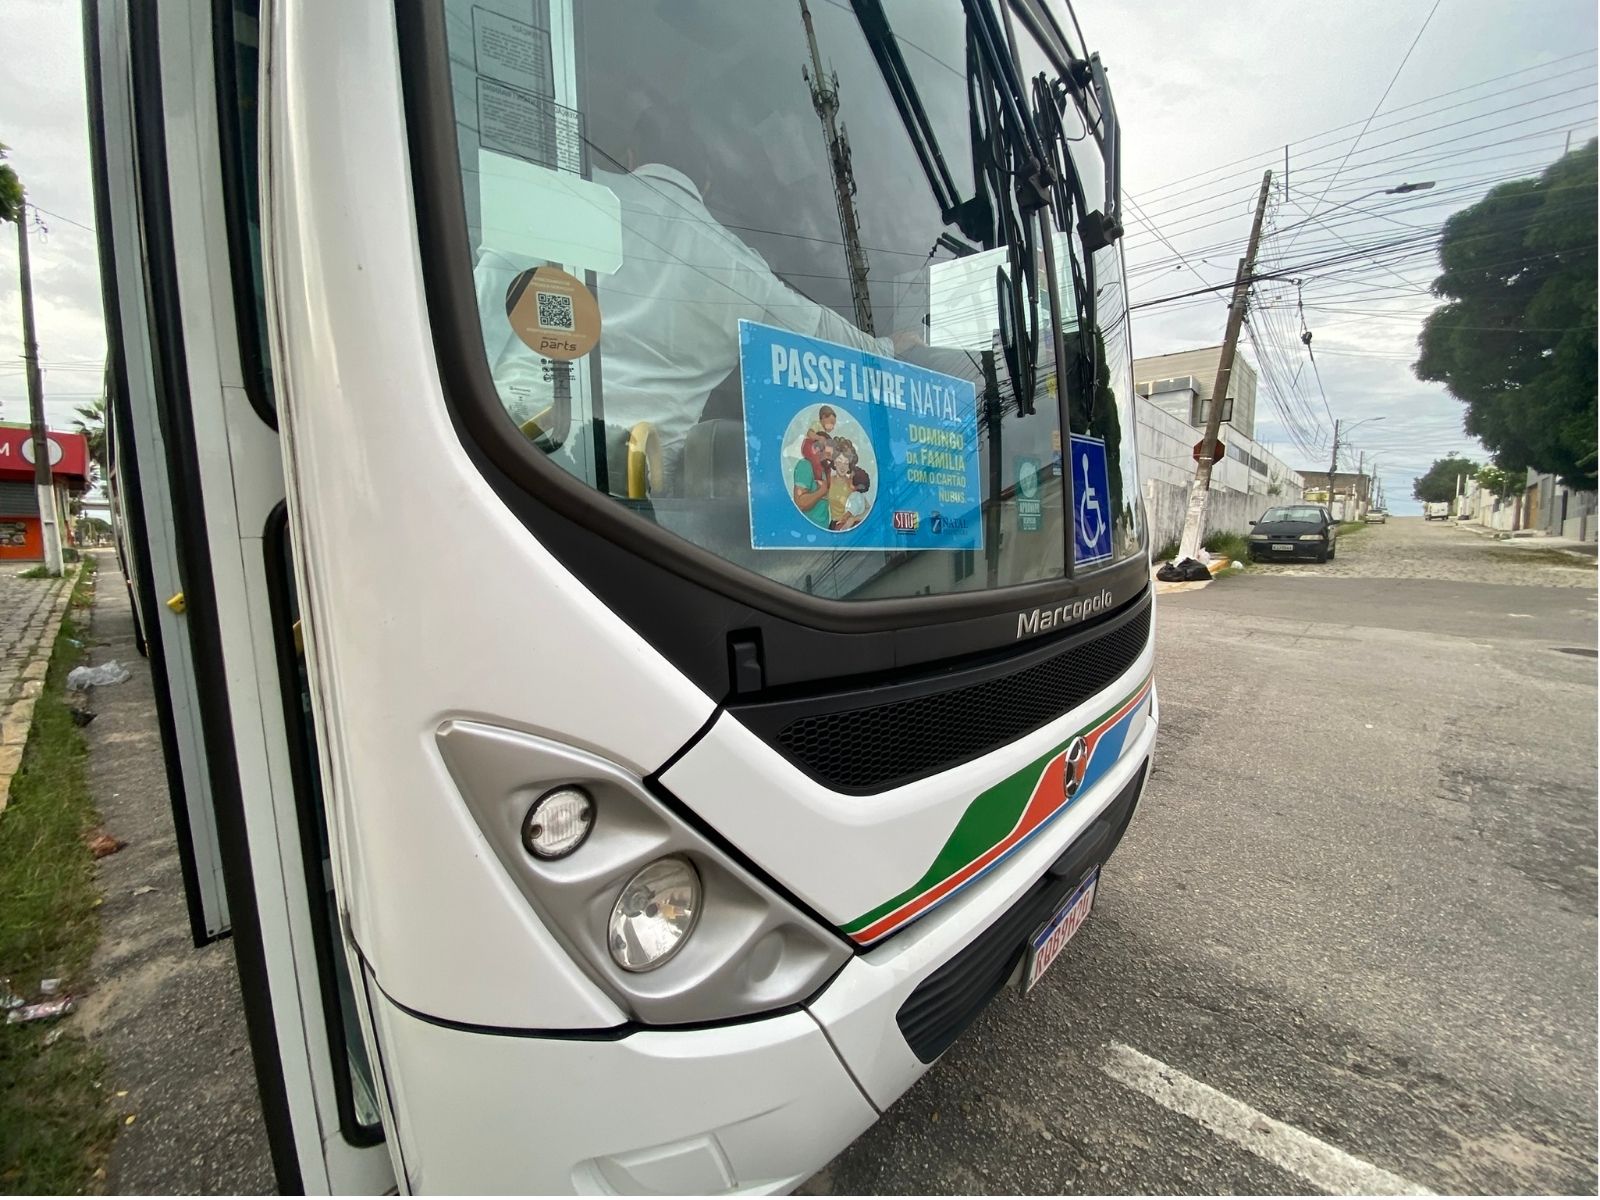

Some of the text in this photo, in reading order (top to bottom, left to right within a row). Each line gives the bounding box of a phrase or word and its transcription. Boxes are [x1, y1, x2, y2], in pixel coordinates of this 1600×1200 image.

[540, 340, 577, 351] parts
[771, 343, 962, 423] PASSE LIVRE NATAL
[909, 424, 964, 451] DOMINGO
[906, 451, 918, 465] DA
[907, 469, 967, 489] COM O CARTÃO
[1016, 588, 1113, 639] Marcopolo
